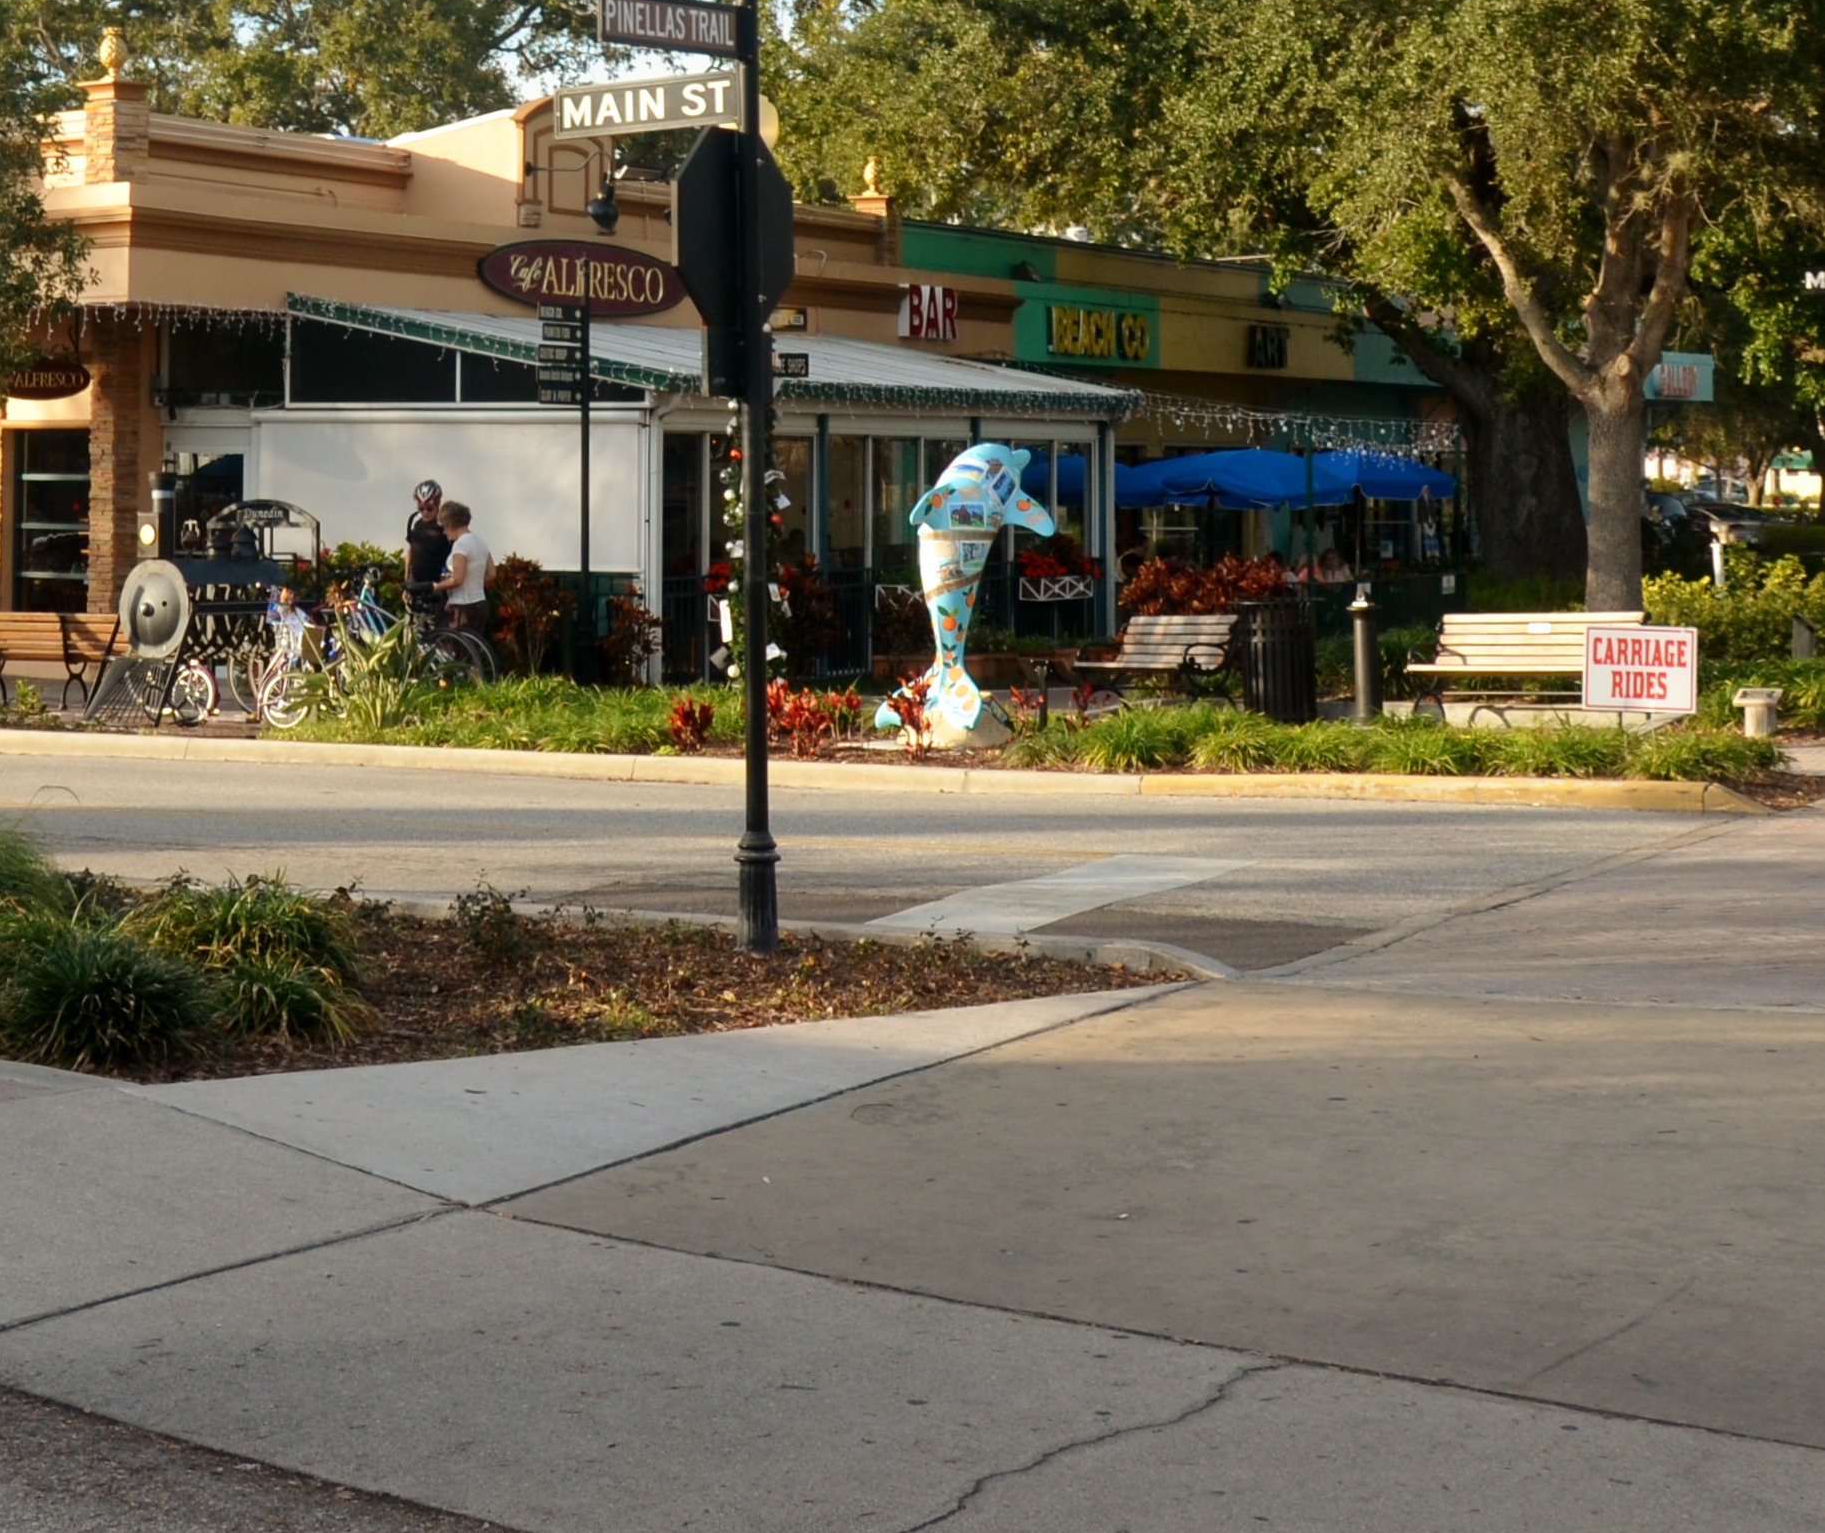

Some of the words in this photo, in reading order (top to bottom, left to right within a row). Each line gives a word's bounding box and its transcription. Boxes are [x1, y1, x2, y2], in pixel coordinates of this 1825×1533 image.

[690, 10, 735, 47] TRAIL
[562, 89, 666, 130] MAIN
[680, 80, 731, 116] ST
[541, 256, 664, 304] ALFRESCO
[908, 284, 958, 340] BAR
[1049, 306, 1116, 357] BEACH
[1120, 313, 1150, 360] CO
[15, 372, 84, 387] ALFRESCO
[1592, 637, 1688, 668] CARRIAGE
[1611, 671, 1668, 700] RIDES
